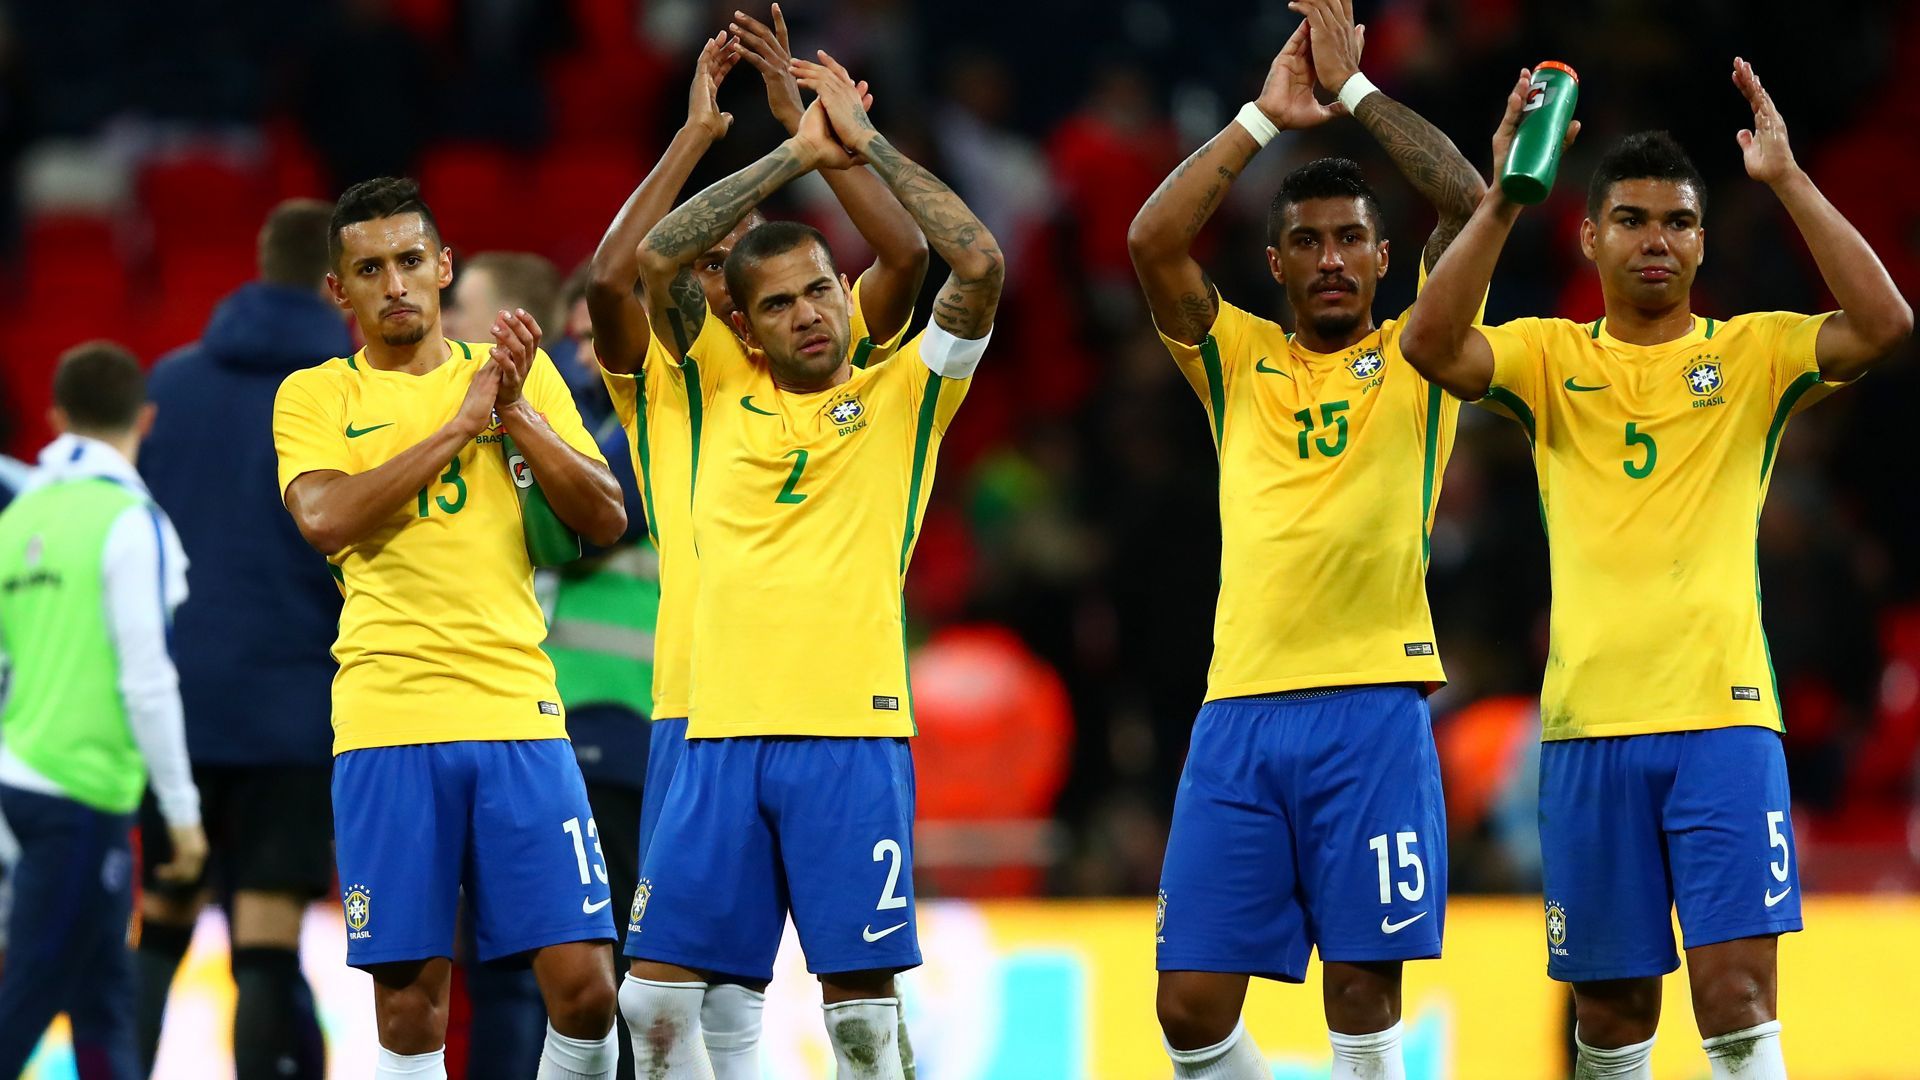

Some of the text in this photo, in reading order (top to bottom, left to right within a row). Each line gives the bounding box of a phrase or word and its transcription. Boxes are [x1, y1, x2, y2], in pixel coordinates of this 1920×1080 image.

[1362, 375, 1385, 395] BRAS
[1692, 396, 1726, 409] BRASIL
[475, 434, 502, 445] BRAS
[838, 419, 868, 437] BRASIL
[1293, 400, 1350, 459] 15
[1623, 422, 1658, 480] 5
[775, 449, 808, 504] 2
[562, 817, 609, 885] 13
[873, 839, 907, 911] 2
[1369, 831, 1425, 904] 15
[1766, 810, 1789, 882] 5
